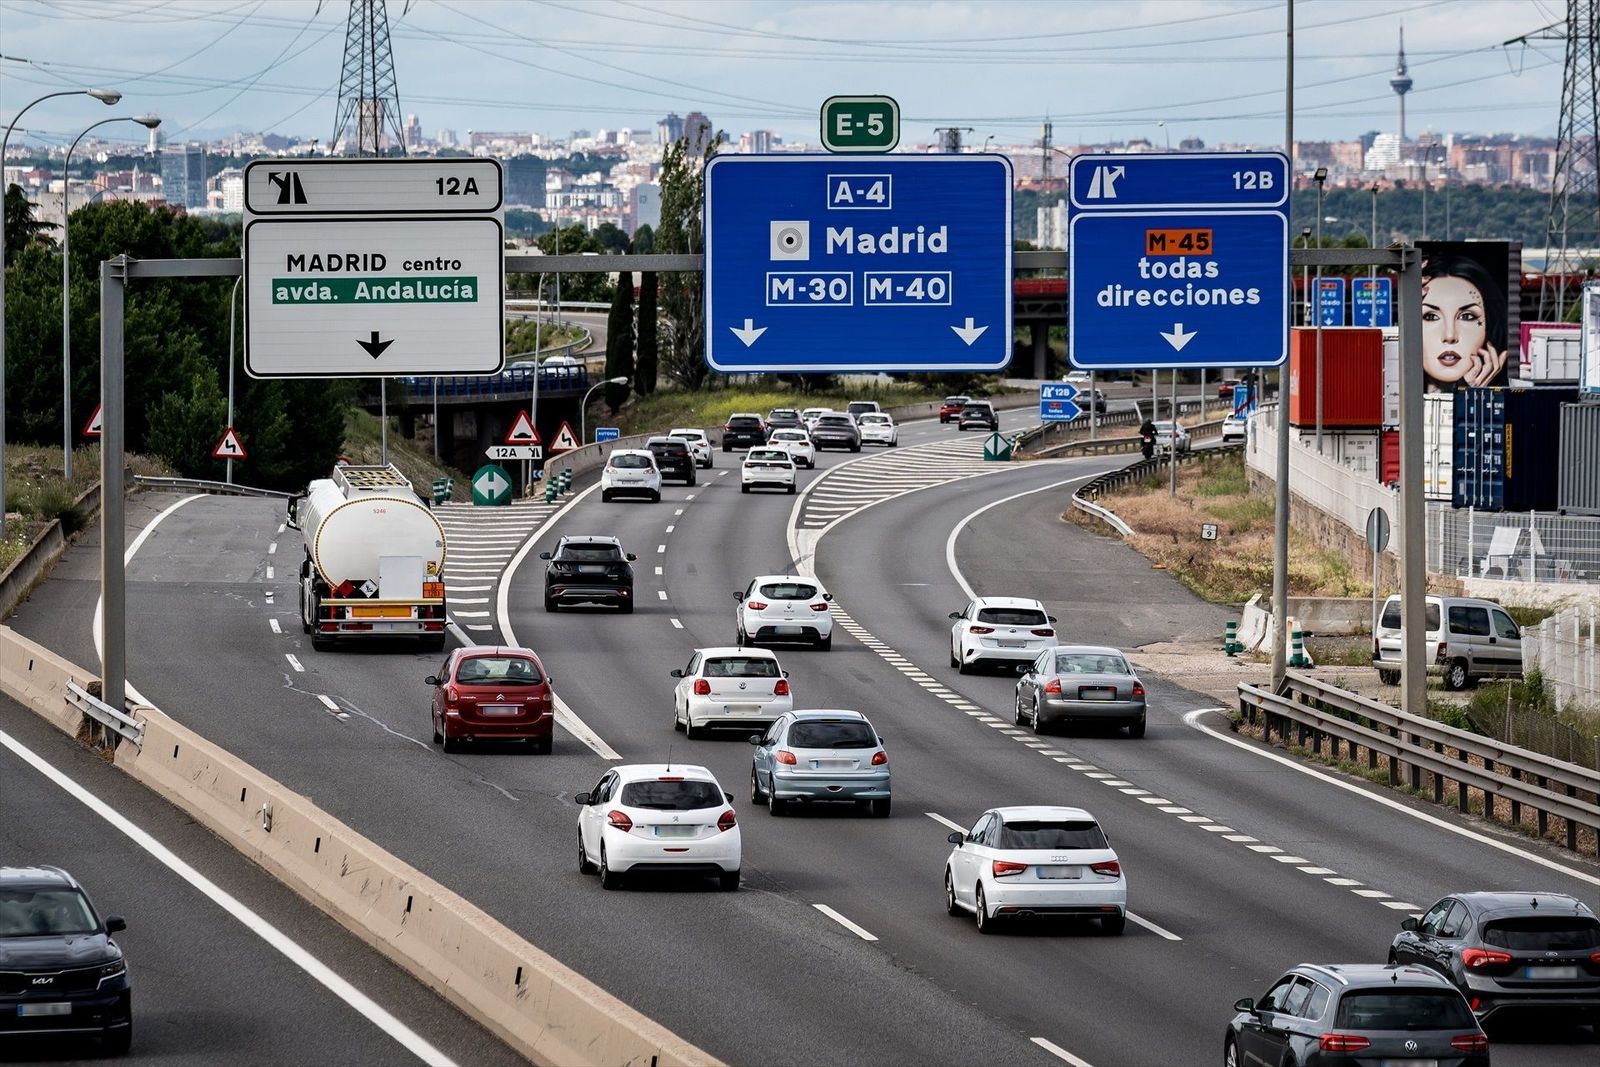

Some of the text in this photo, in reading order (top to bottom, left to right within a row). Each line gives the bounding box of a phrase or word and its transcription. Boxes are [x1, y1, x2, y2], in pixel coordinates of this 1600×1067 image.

[836, 113, 884, 136] E-5
[435, 176, 480, 196] 12A
[1232, 171, 1273, 190] 12B
[834, 181, 886, 203] A-4
[826, 225, 948, 254] Madrid
[1149, 232, 1209, 252] M-45
[286, 253, 462, 273] MADRID centro
[1138, 256, 1219, 279] todas
[276, 279, 473, 301] avda. Andalucía
[772, 278, 847, 301] M-30
[870, 277, 946, 300] M-40
[1097, 283, 1260, 307] direcciones
[1054, 388, 1070, 397] 12B
[495, 447, 518, 458] 12A
